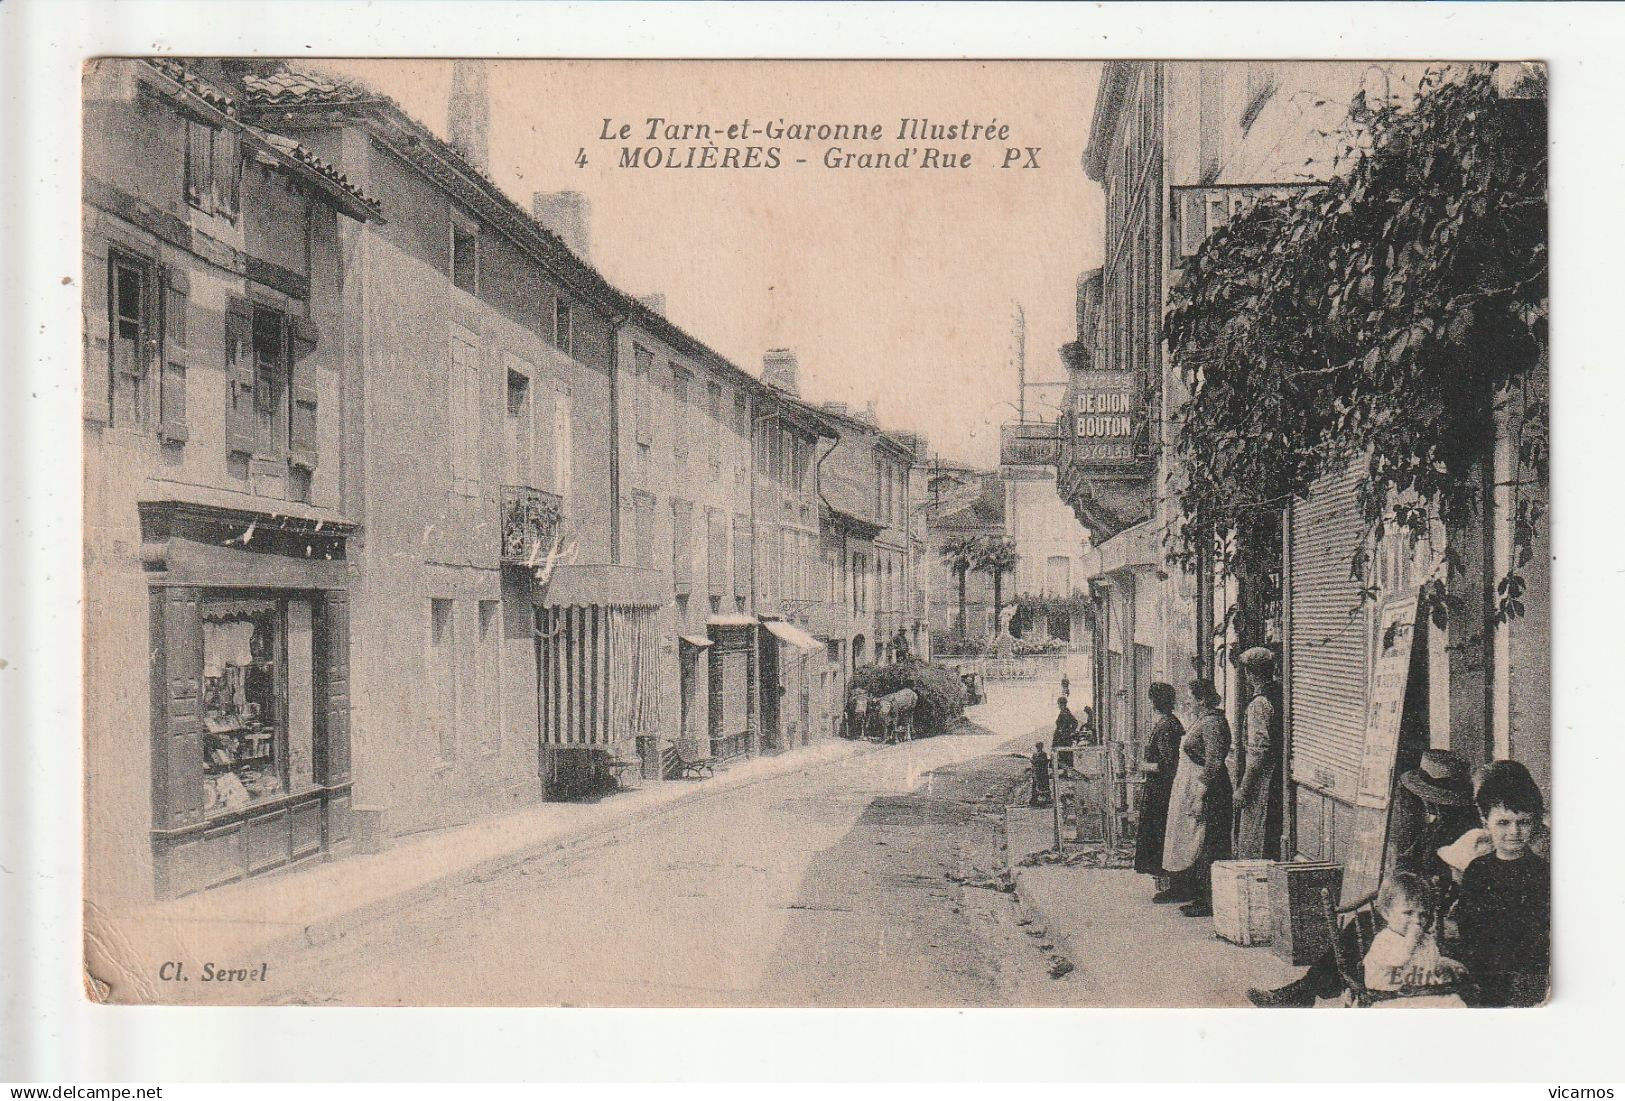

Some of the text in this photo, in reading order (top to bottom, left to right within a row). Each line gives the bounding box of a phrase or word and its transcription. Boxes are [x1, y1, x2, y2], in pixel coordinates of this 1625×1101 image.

[1077, 393, 1130, 413] DE DION
[1076, 417, 1132, 437] BOUTON
